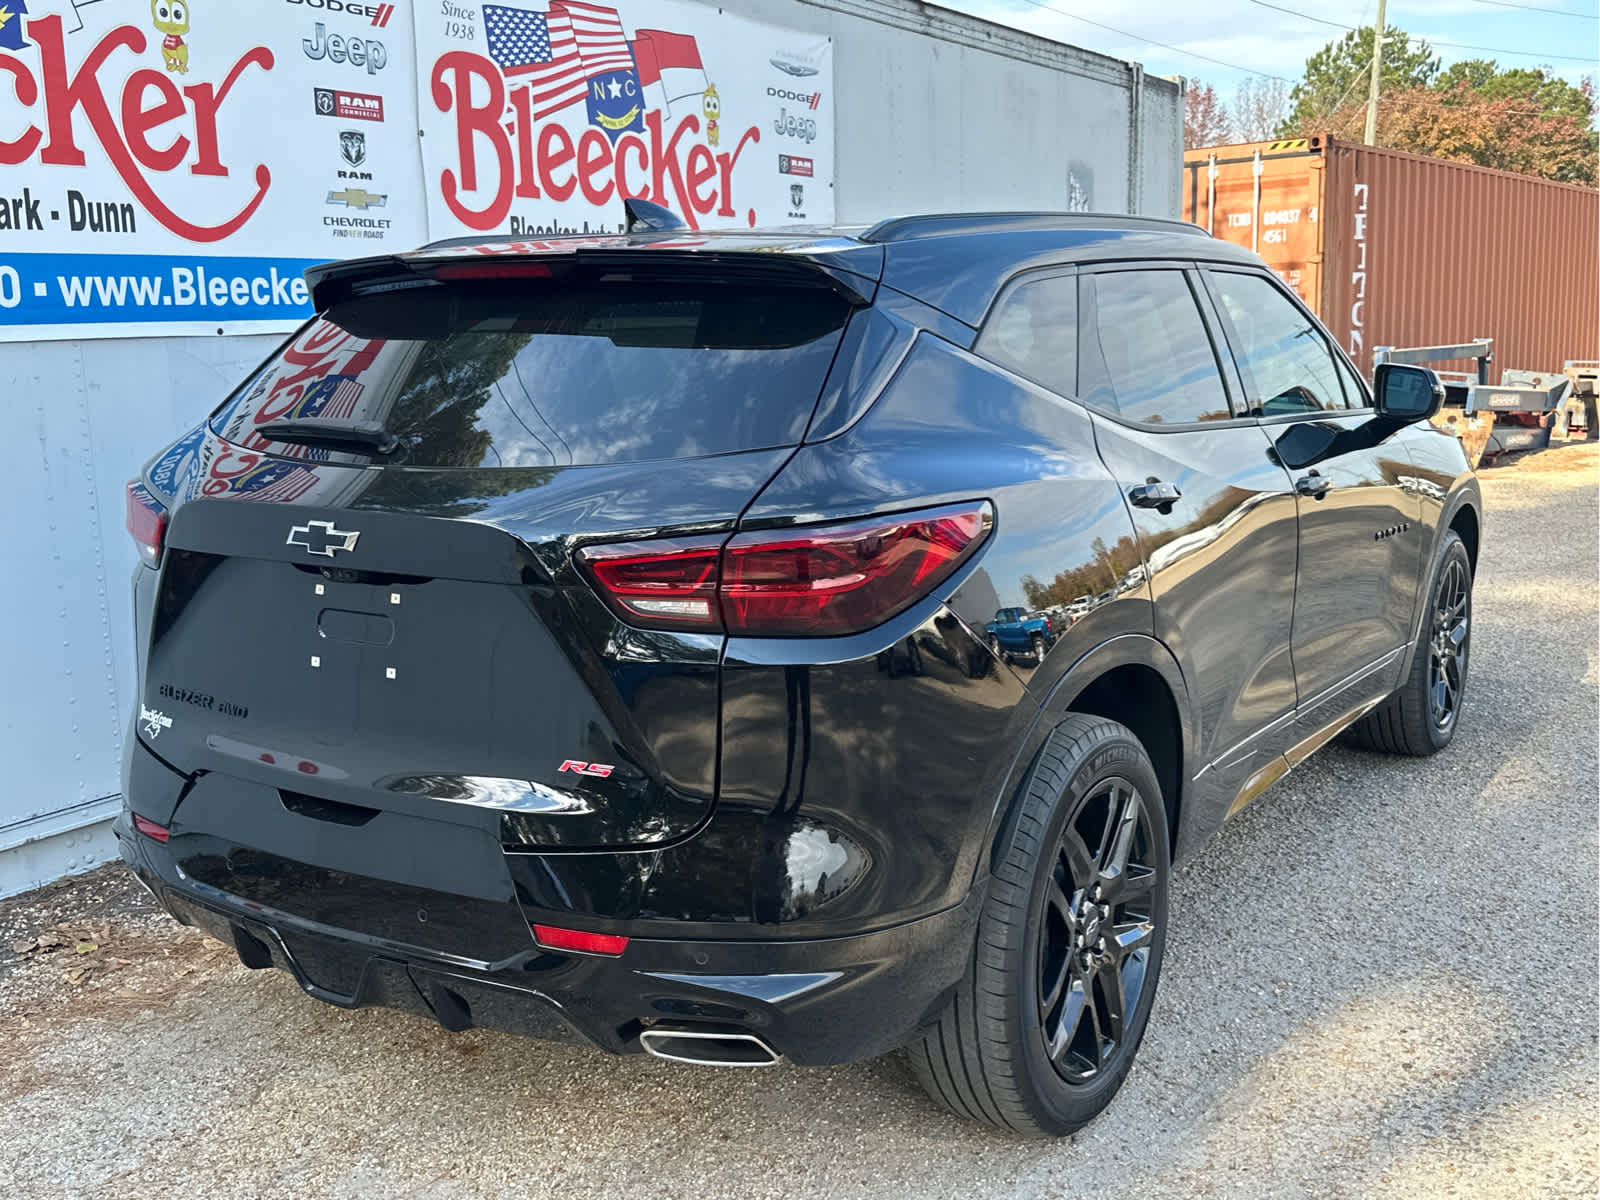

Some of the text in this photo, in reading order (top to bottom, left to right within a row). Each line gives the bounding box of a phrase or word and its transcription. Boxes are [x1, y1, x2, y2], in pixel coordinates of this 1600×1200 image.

[441, 0, 475, 21] Since
[444, 21, 475, 41] 1938
[302, 22, 387, 75] Jeep
[593, 79, 636, 101] N C
[767, 87, 814, 104] DODGE
[339, 95, 380, 109] RAM
[340, 108, 380, 119] COMMERCIAL
[774, 107, 817, 144] Jeep
[431, 51, 761, 230] Bleecker
[791, 159, 812, 169] RAM
[337, 170, 373, 181] RAM
[0, 188, 136, 233] ark Dunn
[787, 211, 807, 219] RAM
[323, 216, 392, 229] CHEVROLET
[57, 265, 309, 308] www.Bleecke
[557, 759, 615, 778] RS
